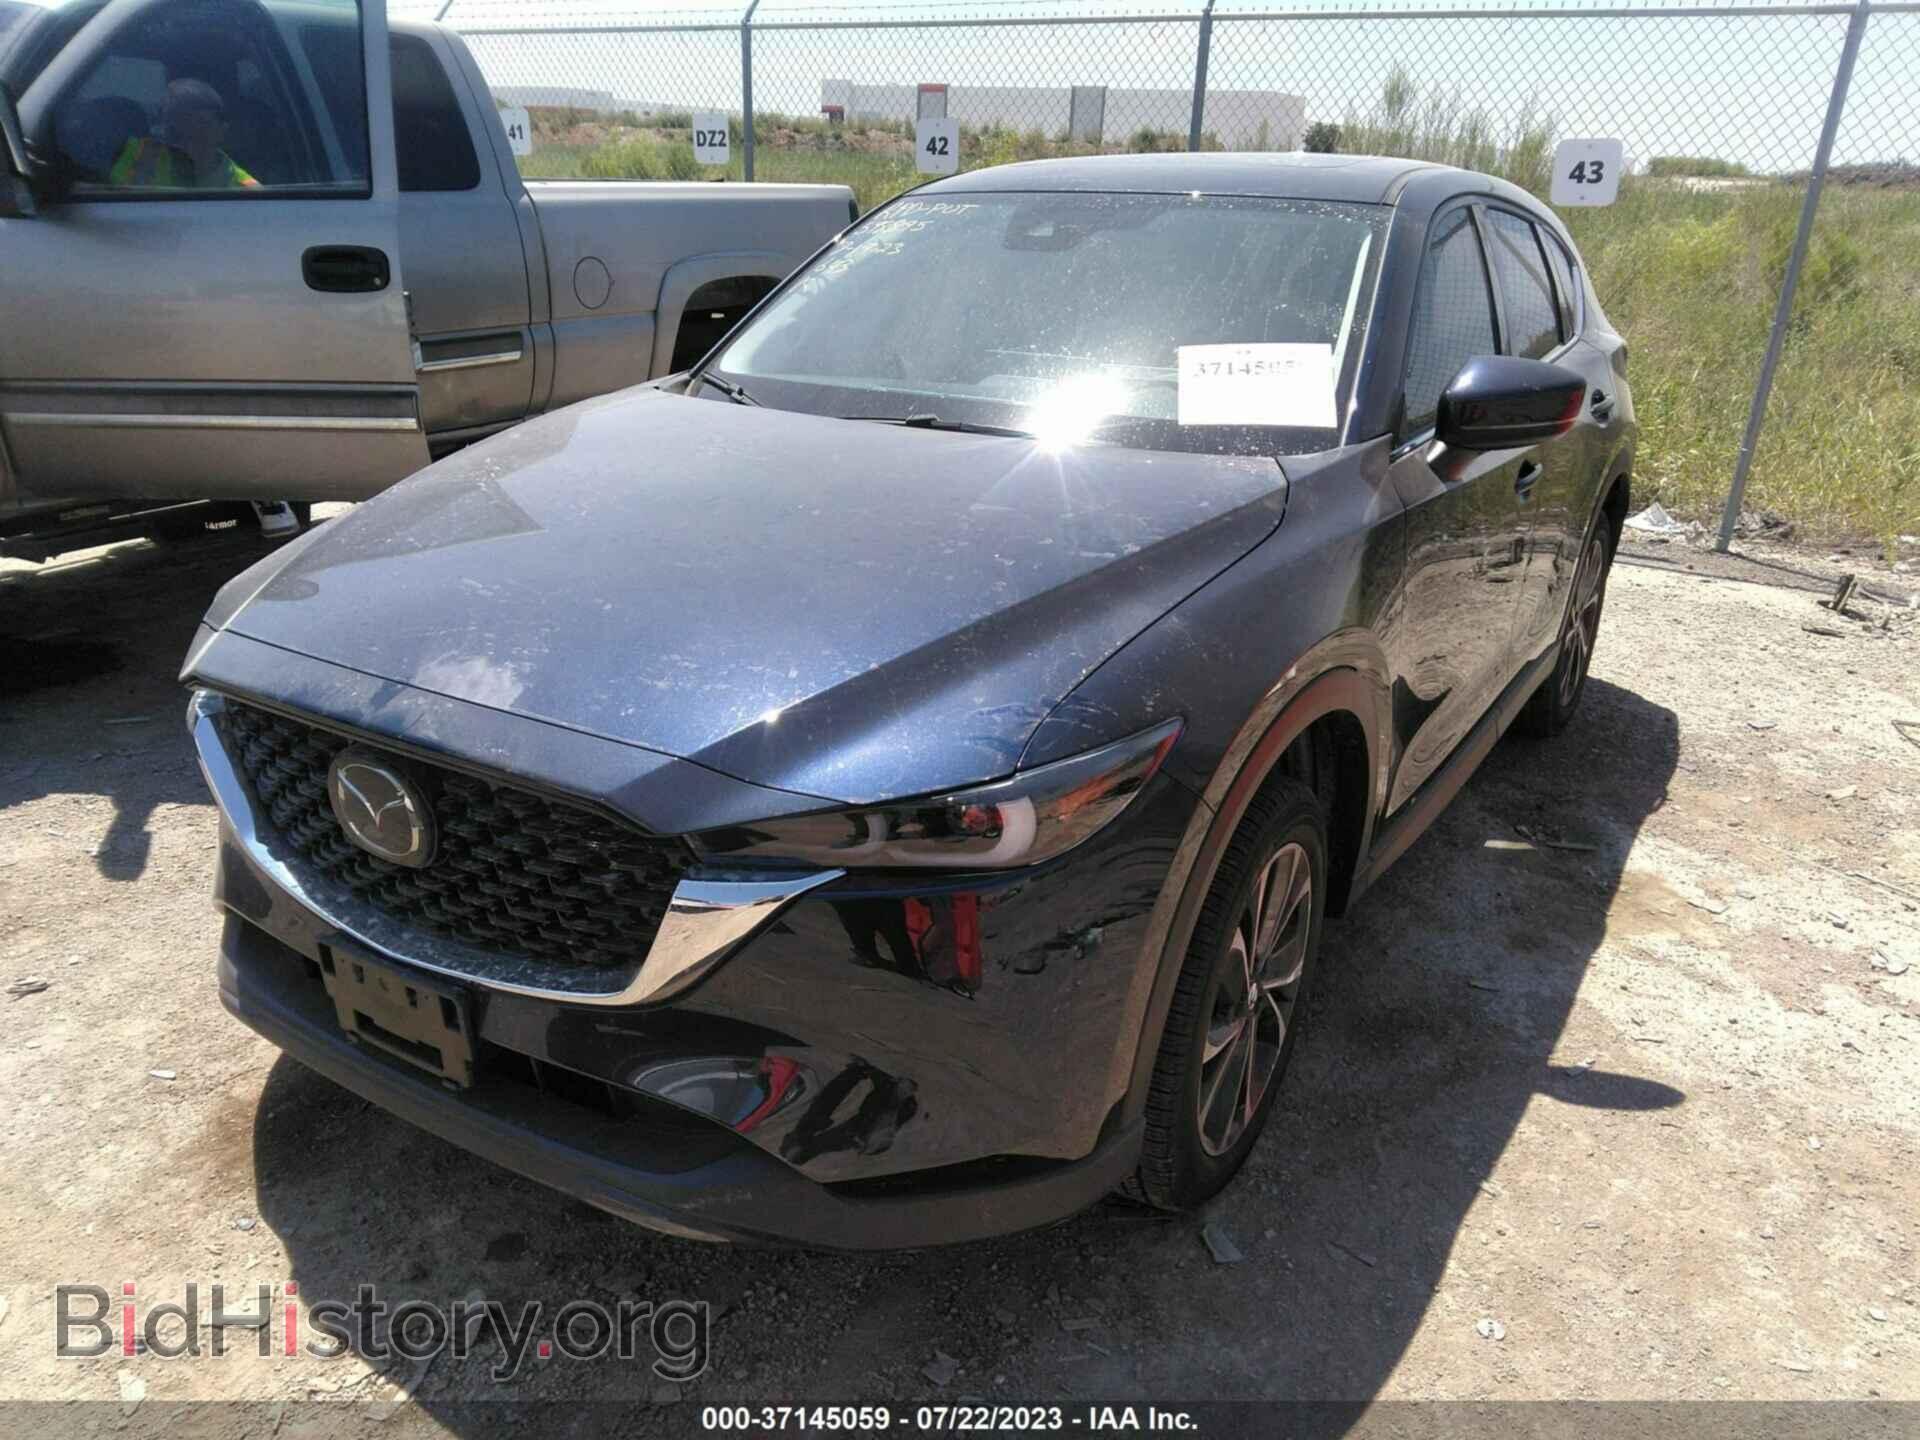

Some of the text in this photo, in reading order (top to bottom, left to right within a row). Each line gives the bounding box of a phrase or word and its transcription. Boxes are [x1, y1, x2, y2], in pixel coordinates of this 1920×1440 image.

[508, 124, 523, 140] 41
[696, 129, 727, 147] DZ2
[926, 136, 949, 155] 42
[1568, 160, 1605, 184] 43
